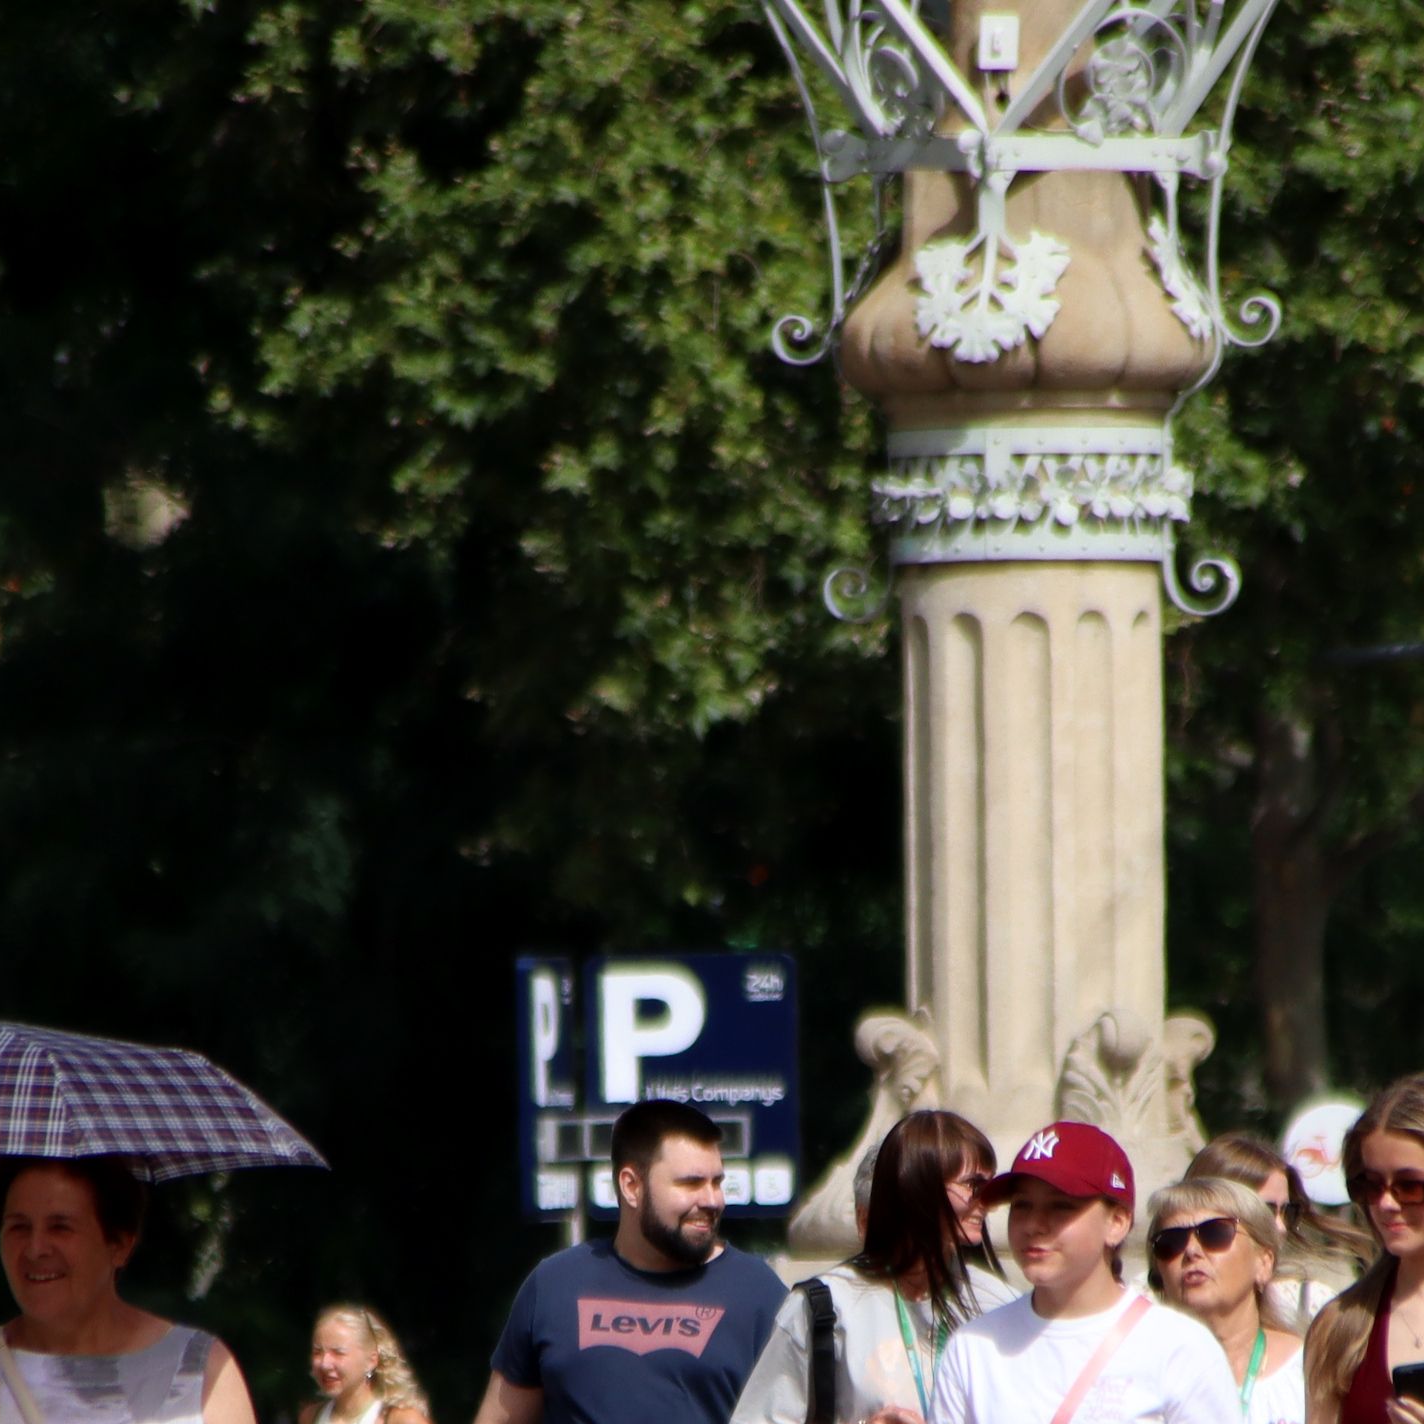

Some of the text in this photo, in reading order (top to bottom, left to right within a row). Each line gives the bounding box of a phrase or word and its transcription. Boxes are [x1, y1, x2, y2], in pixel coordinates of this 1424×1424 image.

[602, 973, 706, 1103] P
[691, 1082, 785, 1107] Companys
[1024, 1131, 1060, 1160] NY
